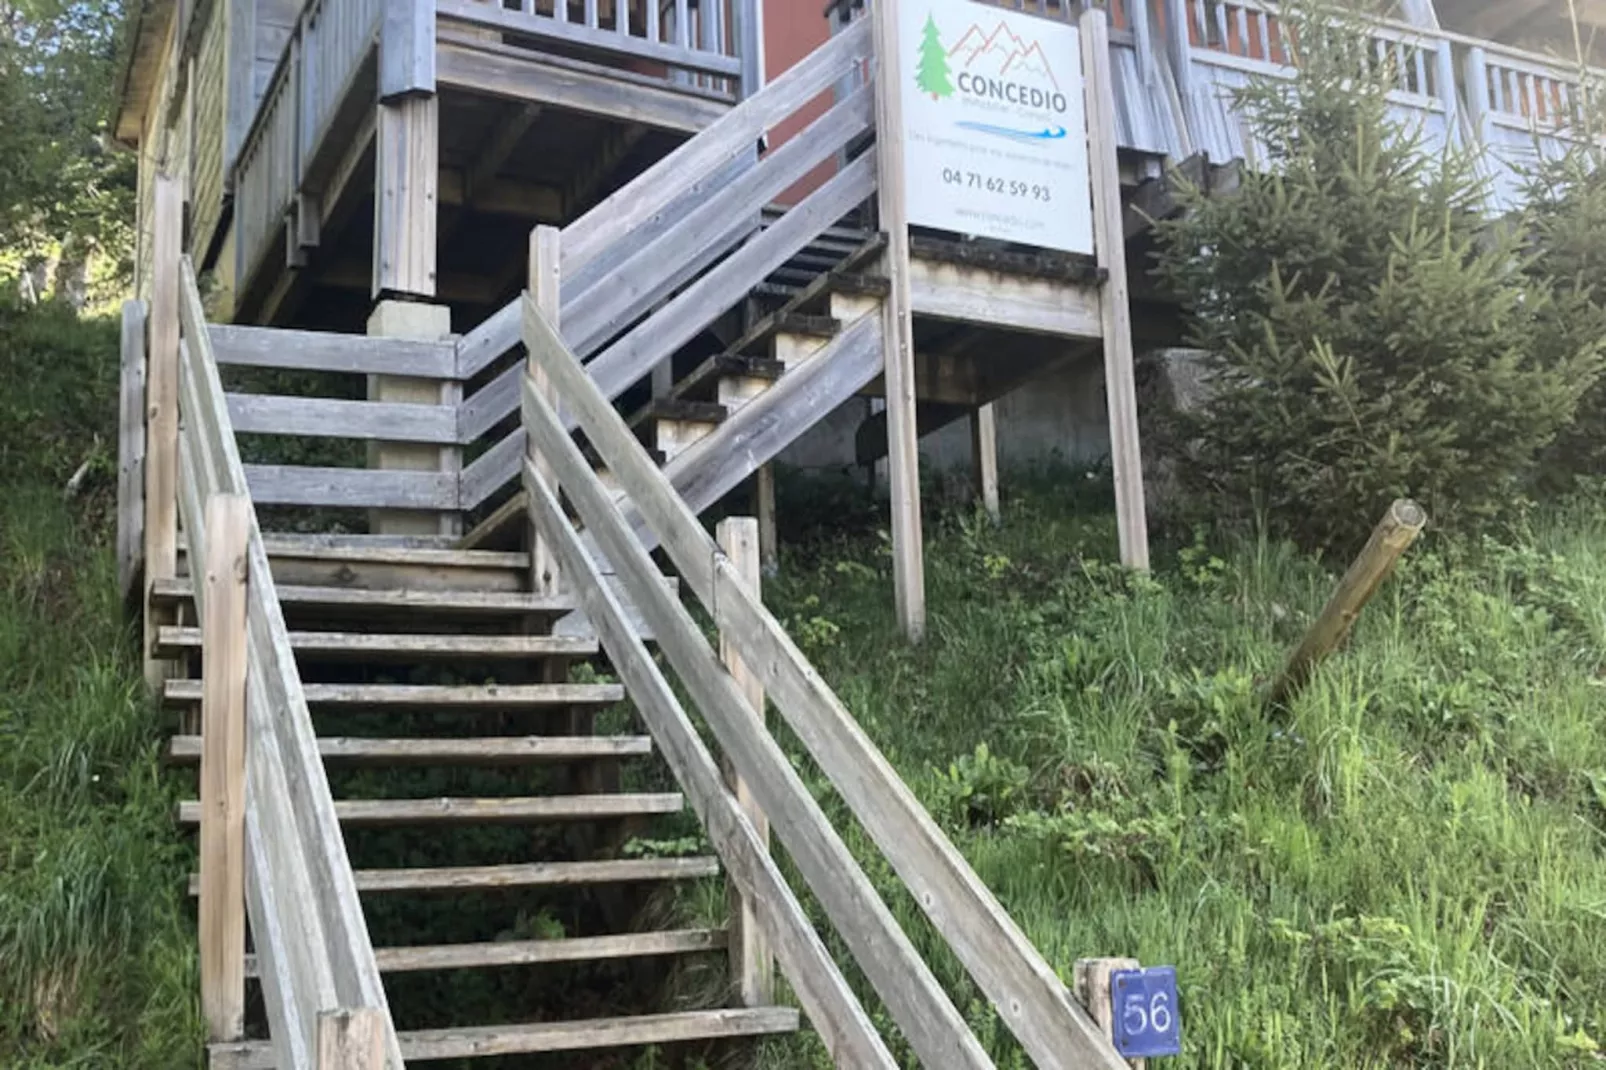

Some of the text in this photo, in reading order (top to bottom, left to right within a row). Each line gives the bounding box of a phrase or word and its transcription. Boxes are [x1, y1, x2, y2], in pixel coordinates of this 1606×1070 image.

[957, 72, 1067, 113] CONCEDIO
[943, 168, 1051, 202] 04 71 62 59 93
[1123, 991, 1172, 1036] 56
